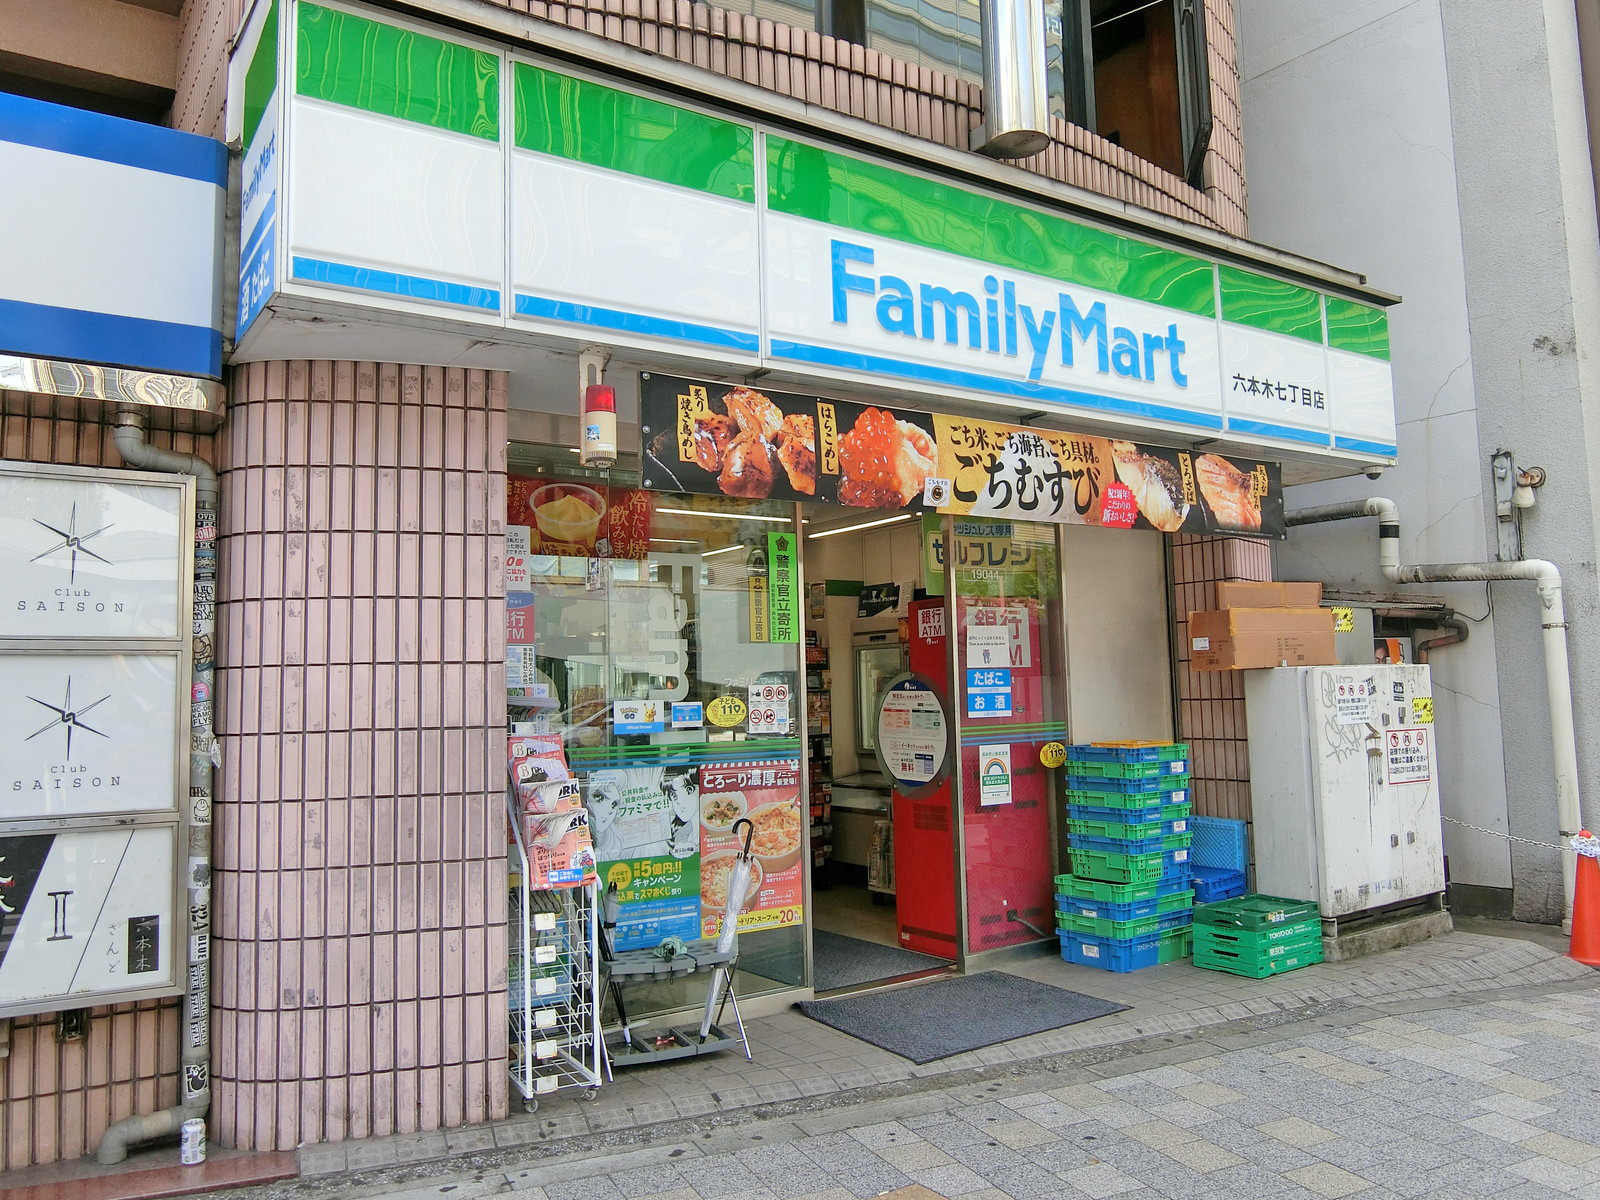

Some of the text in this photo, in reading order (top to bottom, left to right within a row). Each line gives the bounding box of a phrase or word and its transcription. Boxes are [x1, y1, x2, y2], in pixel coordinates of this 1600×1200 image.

[243, 128, 275, 218] FamilyMart
[240, 249, 270, 326] 酒 たばこ
[830, 238, 1188, 388] FamilyMart
[1232, 373, 1325, 410] 六本木七丁目店
[680, 398, 693, 460] 焼き鳥めし
[820, 407, 835, 472] はらこめし
[951, 425, 1100, 464] ごち米、ごち海苔、ごち具材。
[953, 452, 1100, 517] ごちむすび
[1181, 456, 1194, 503] とろさば
[972, 569, 999, 580] 19044
[55, 588, 91, 597] Club
[776, 554, 791, 641] 警察官立寄所
[17, 600, 124, 613] SAISON
[922, 608, 942, 624] 銀行
[922, 625, 942, 636] ATM
[974, 671, 1004, 685] たばこ
[718, 697, 736, 706] 子ども
[974, 695, 1006, 709] お 酒
[50, 764, 87, 774] Club
[13, 776, 121, 791] SAISON
[619, 799, 670, 818] ファミマで!!
[633, 874, 682, 888] キャンペーン
[780, 909, 793, 923] 20
[136, 918, 152, 972] 六本木
[198, 935, 207, 960] BLUE
